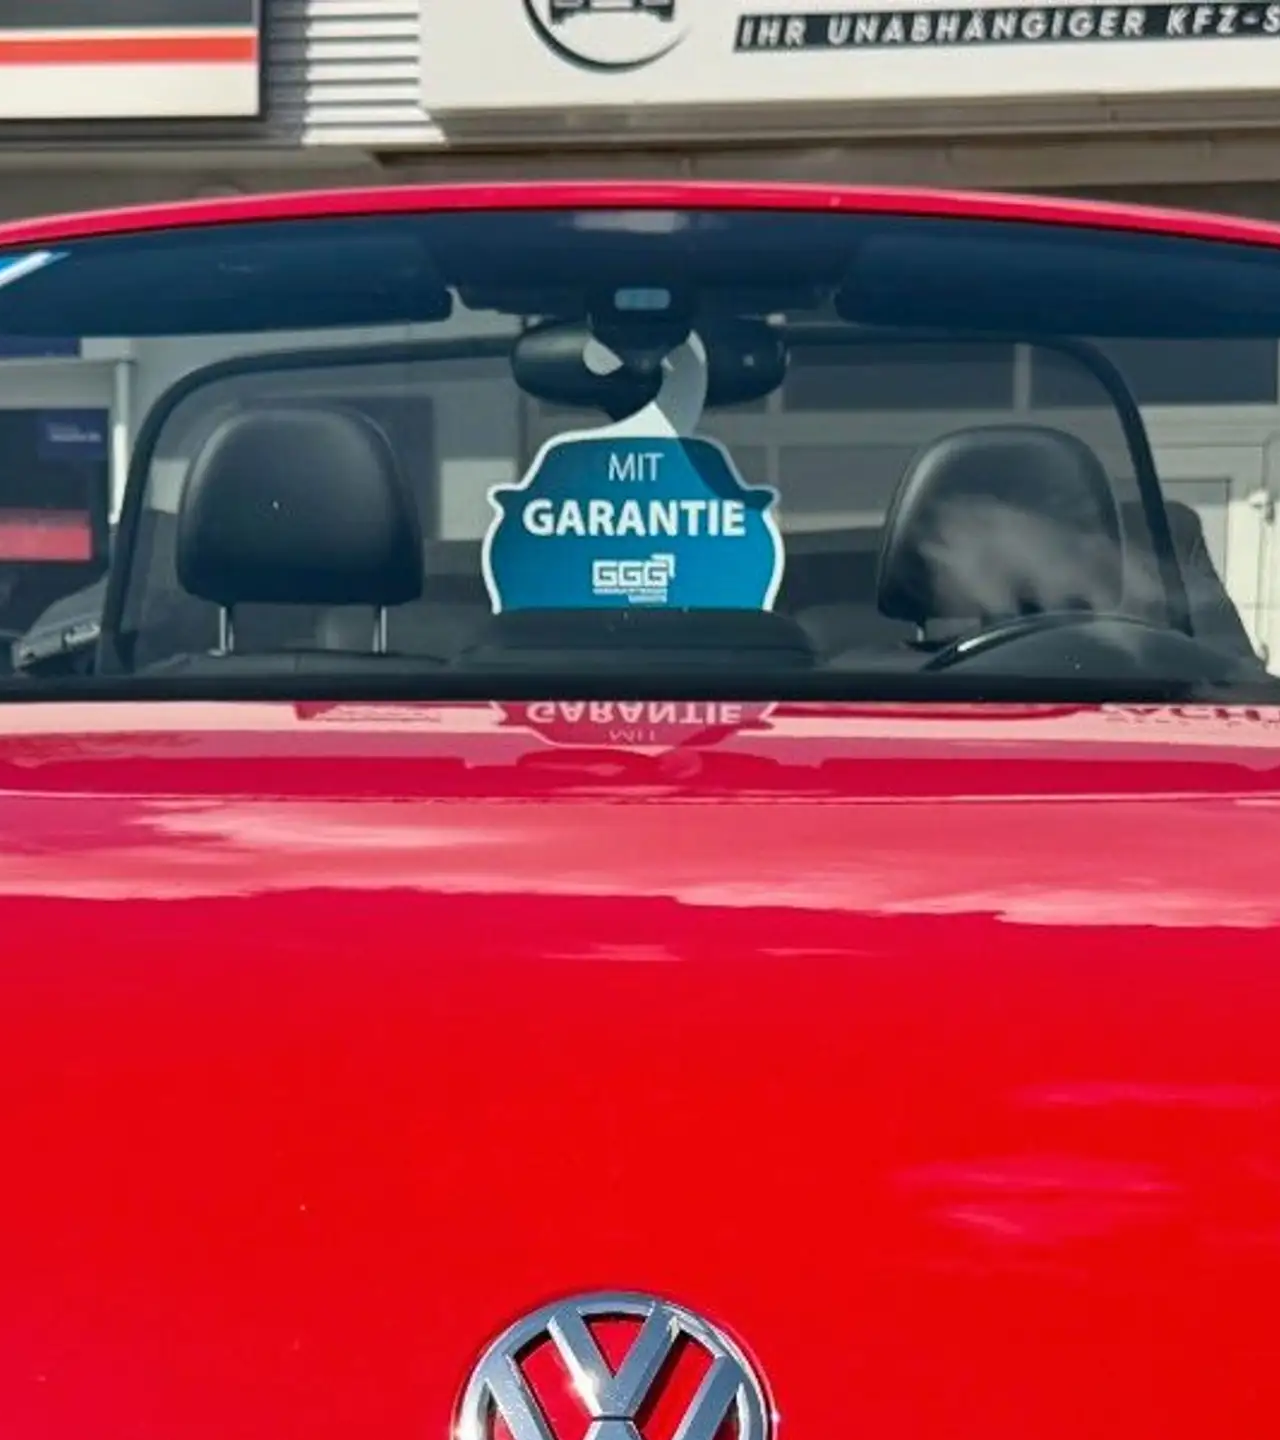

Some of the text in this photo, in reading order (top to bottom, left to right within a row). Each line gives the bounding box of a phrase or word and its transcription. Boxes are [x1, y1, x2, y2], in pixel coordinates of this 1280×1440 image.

[740, 17, 808, 47] IHR
[827, 7, 1146, 45] UNABHÄNGIGER
[608, 453, 665, 482] MIT
[523, 499, 747, 537] GARANTIE
